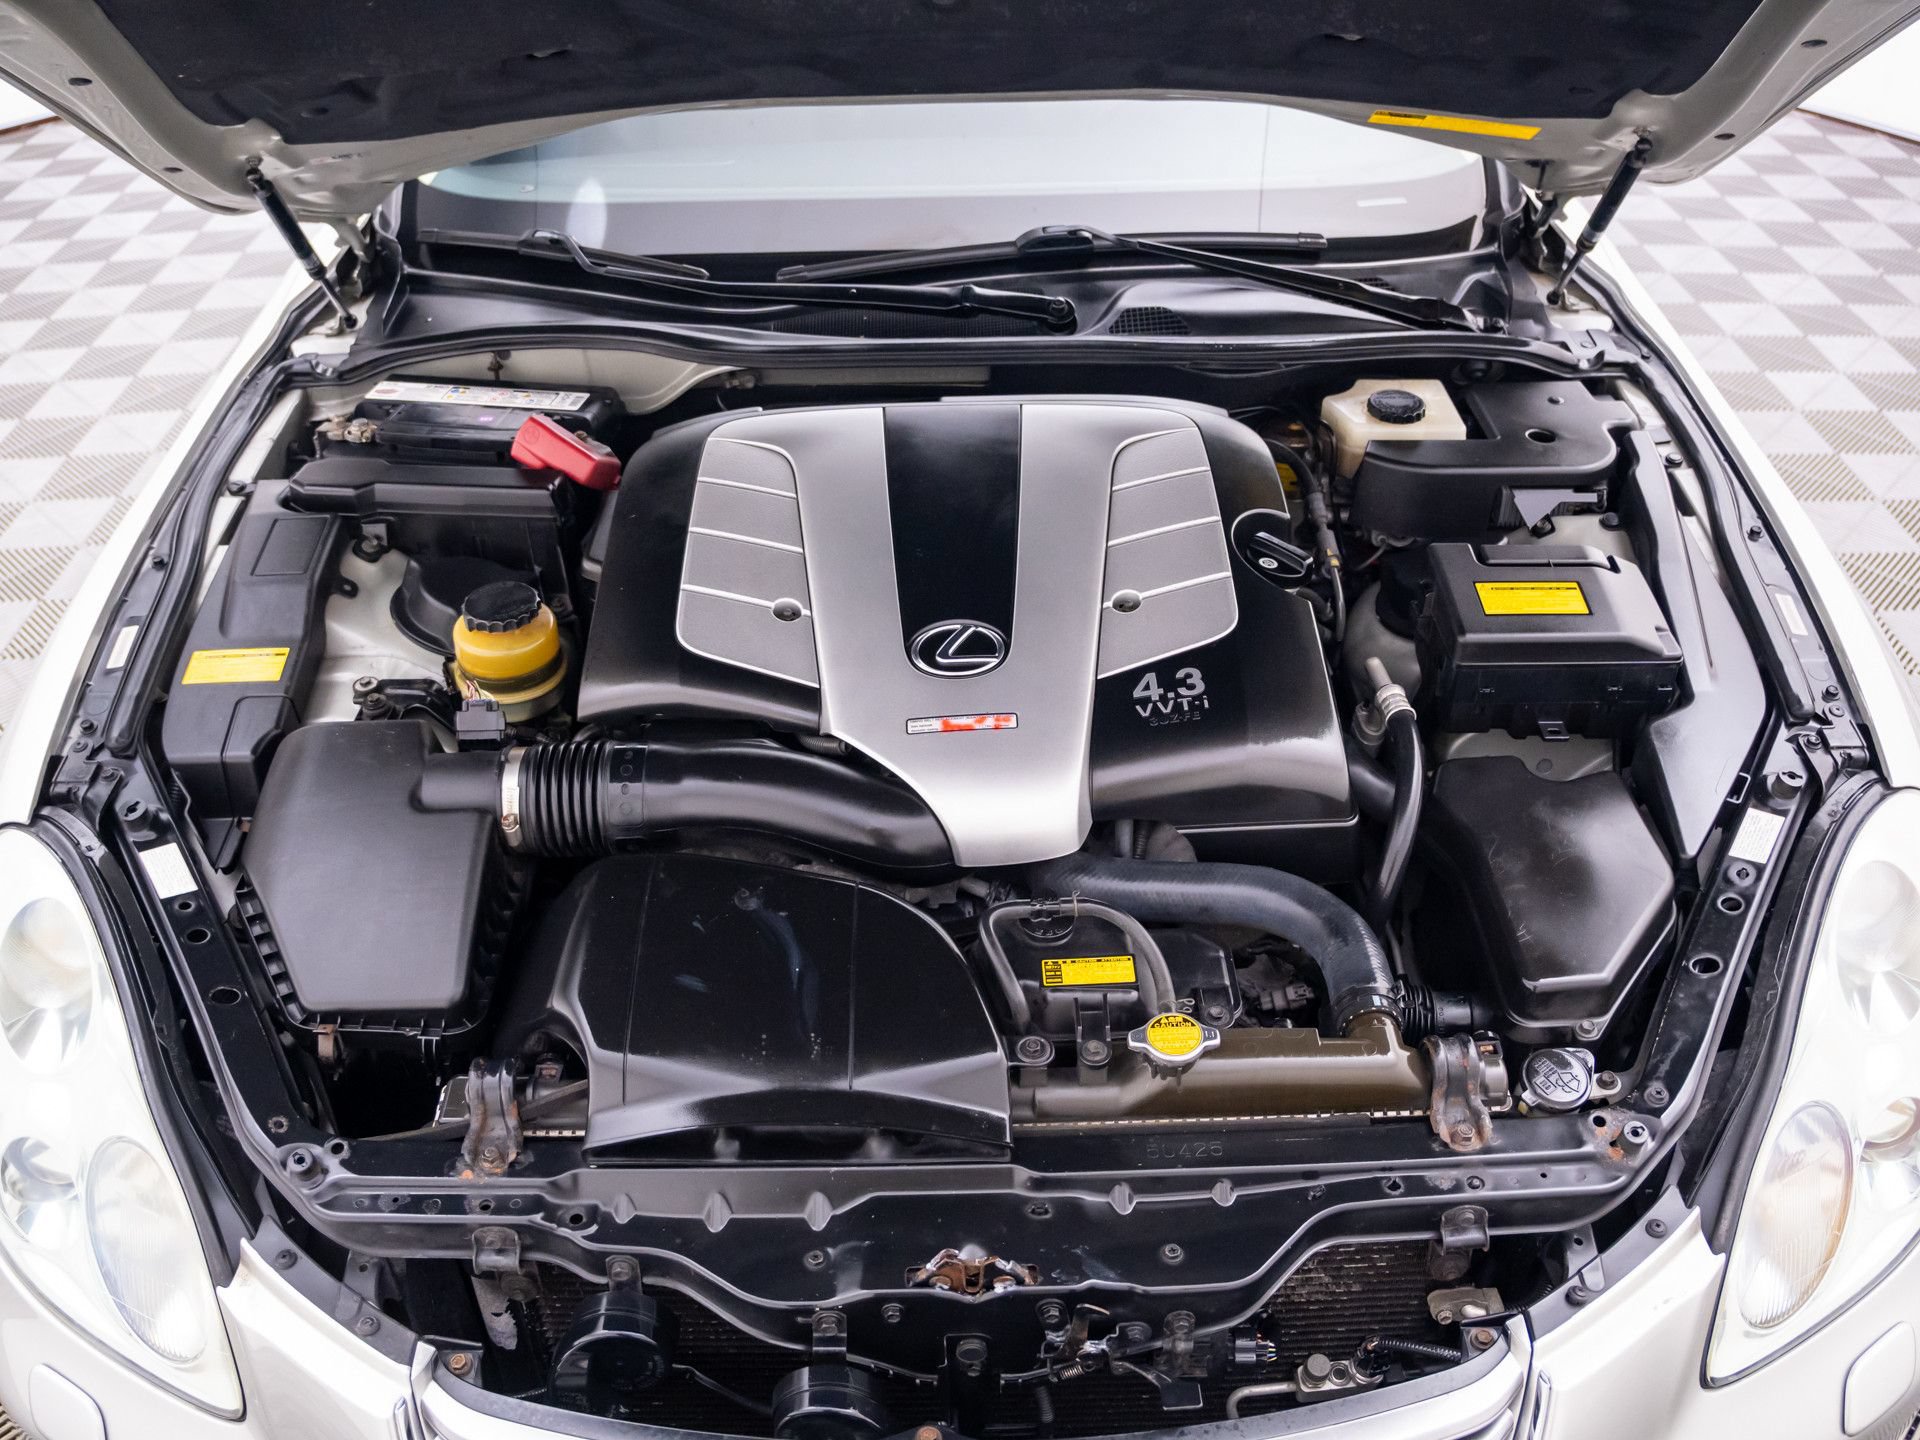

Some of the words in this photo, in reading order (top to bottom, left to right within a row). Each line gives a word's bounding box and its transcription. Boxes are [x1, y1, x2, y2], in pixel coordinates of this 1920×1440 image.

[1132, 667, 1206, 701] 4.3
[1135, 695, 1209, 717] VVT-i
[1154, 1021, 1192, 1029] CAUTION
